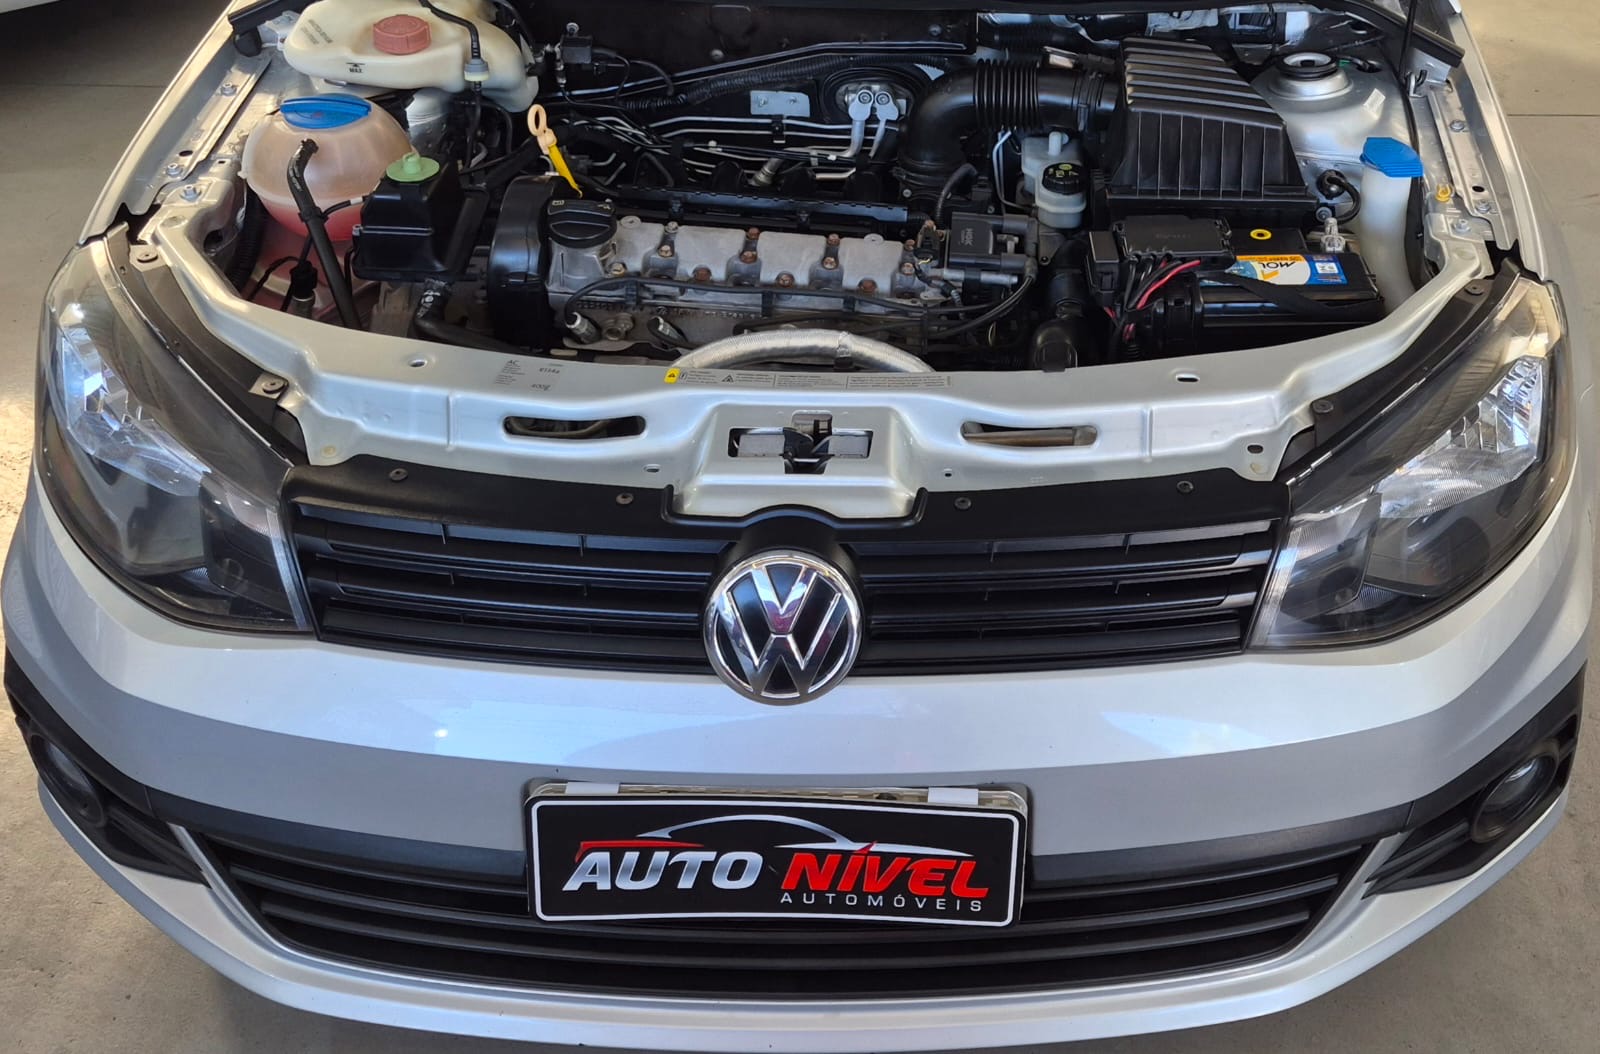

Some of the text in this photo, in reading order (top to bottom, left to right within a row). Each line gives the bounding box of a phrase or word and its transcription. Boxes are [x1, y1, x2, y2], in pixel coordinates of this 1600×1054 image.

[713, 563, 849, 696] VW
[562, 841, 989, 898] AUTO NÍVEL
[780, 892, 982, 912] AUTOMÓVEIS
